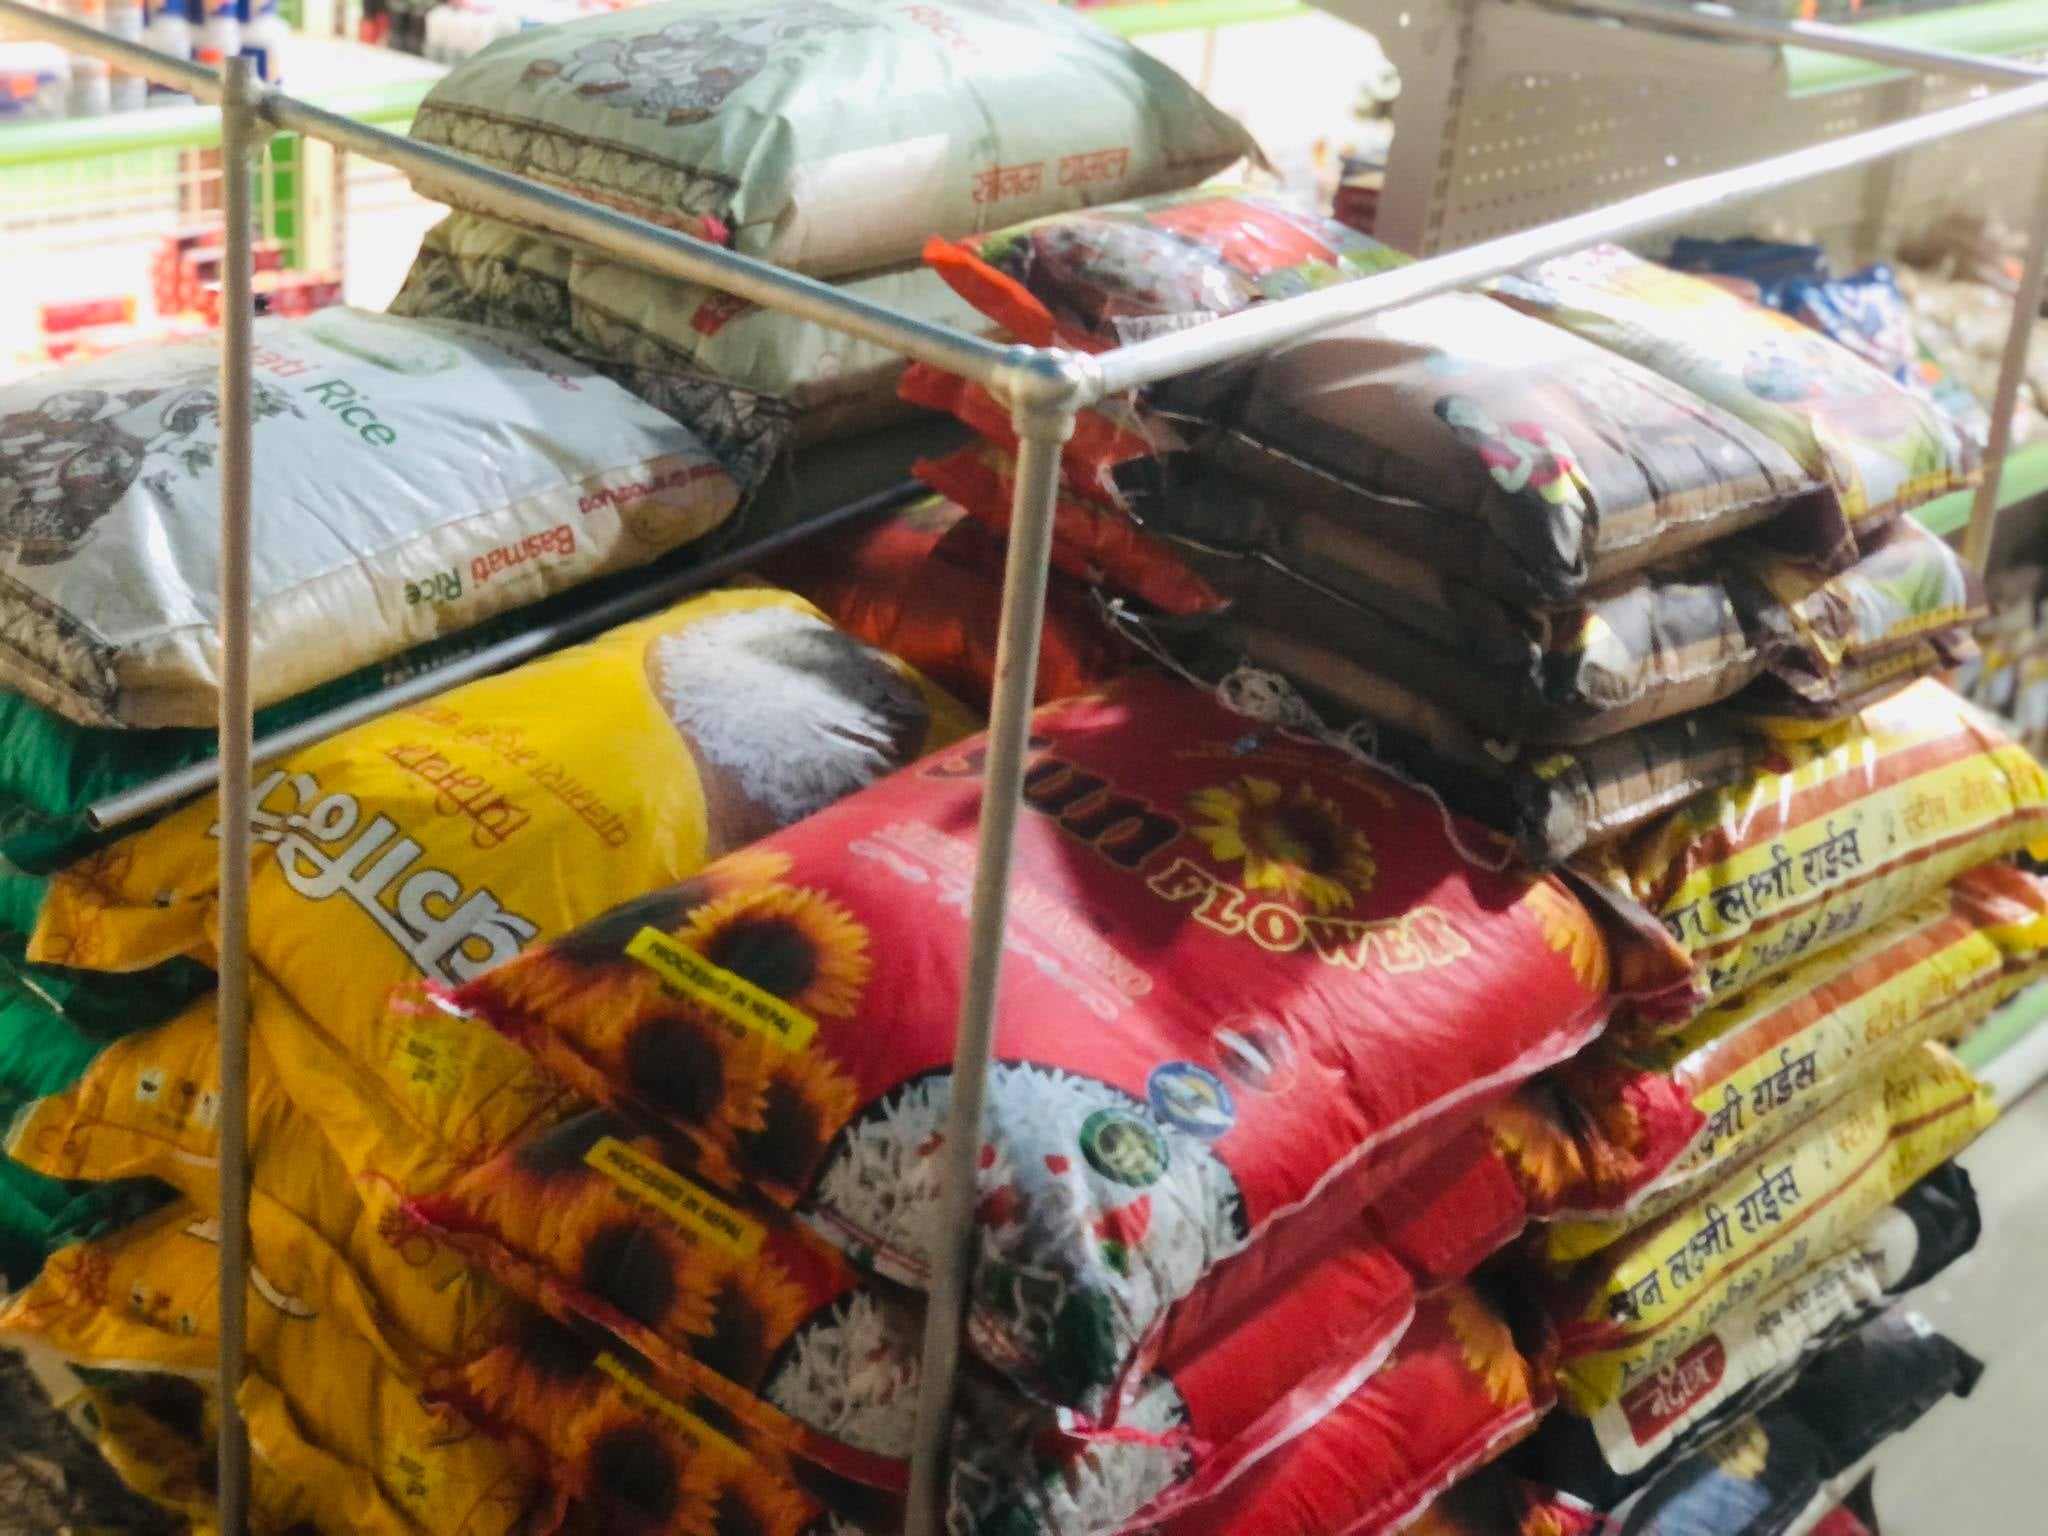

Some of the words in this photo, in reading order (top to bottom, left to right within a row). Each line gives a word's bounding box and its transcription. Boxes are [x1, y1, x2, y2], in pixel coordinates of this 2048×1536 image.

[302, 378, 397, 447] Rice
[404, 566, 463, 606] Rice
[470, 525, 577, 590] Basmati
[1146, 857, 1473, 974] FLOWER
[1664, 1202, 1735, 1289] लक्ष्मी
[1734, 1163, 1803, 1233] राईस
